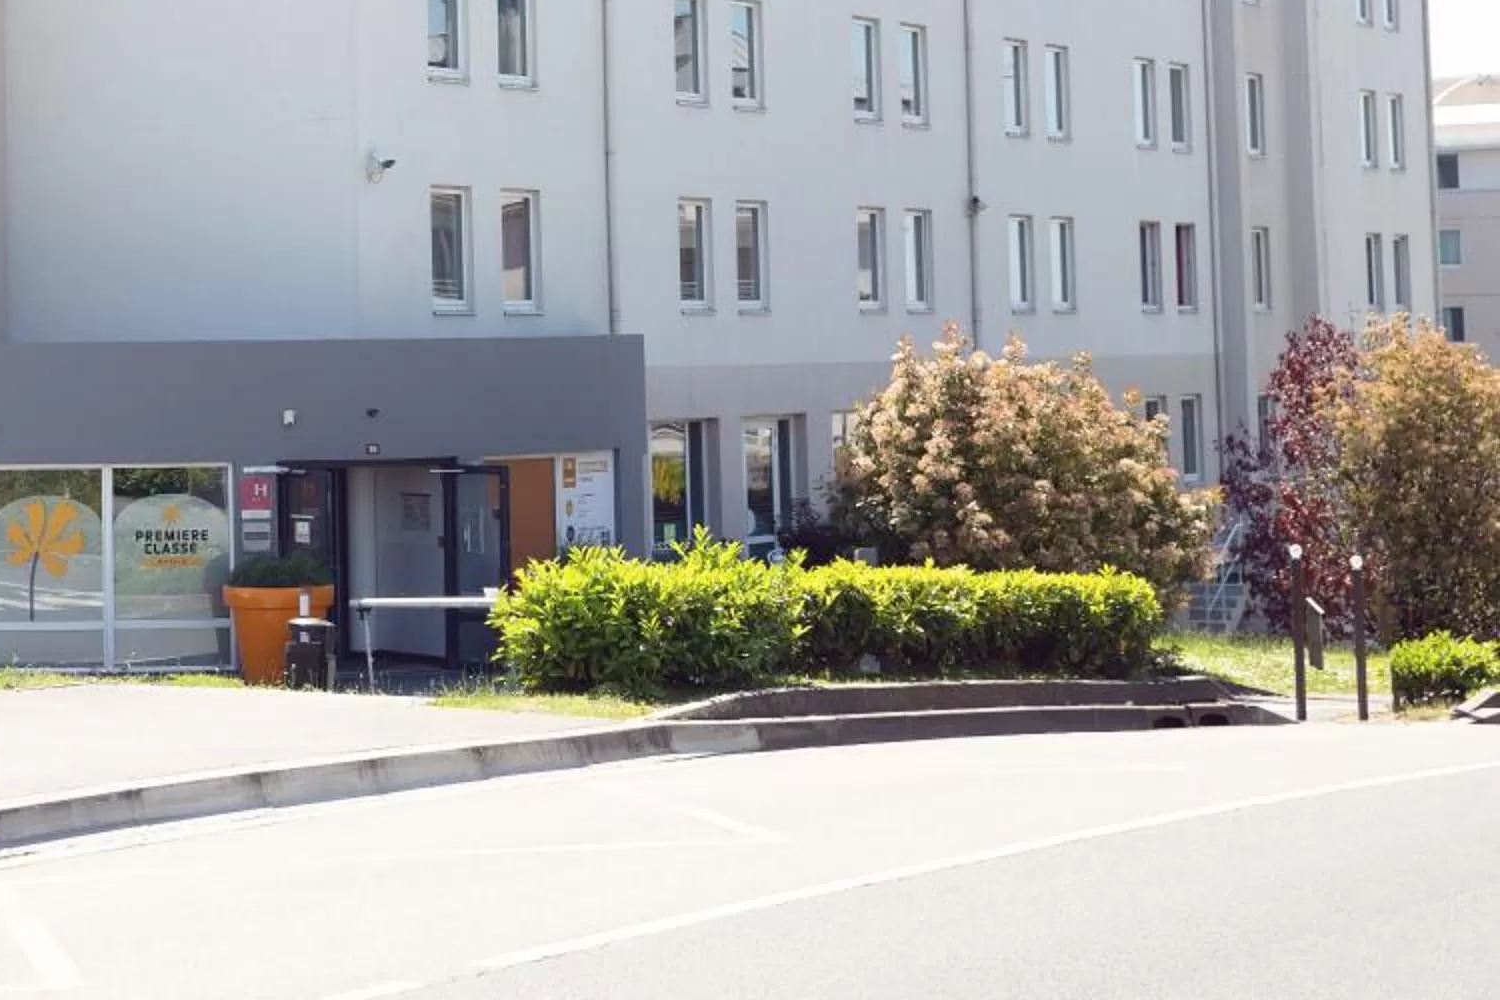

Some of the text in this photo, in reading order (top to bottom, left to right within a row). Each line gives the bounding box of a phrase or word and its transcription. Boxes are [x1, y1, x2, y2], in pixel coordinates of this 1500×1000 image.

[254, 483, 268, 497] H
[135, 529, 209, 542] PREMIERE
[144, 542, 198, 555] CLASSE
